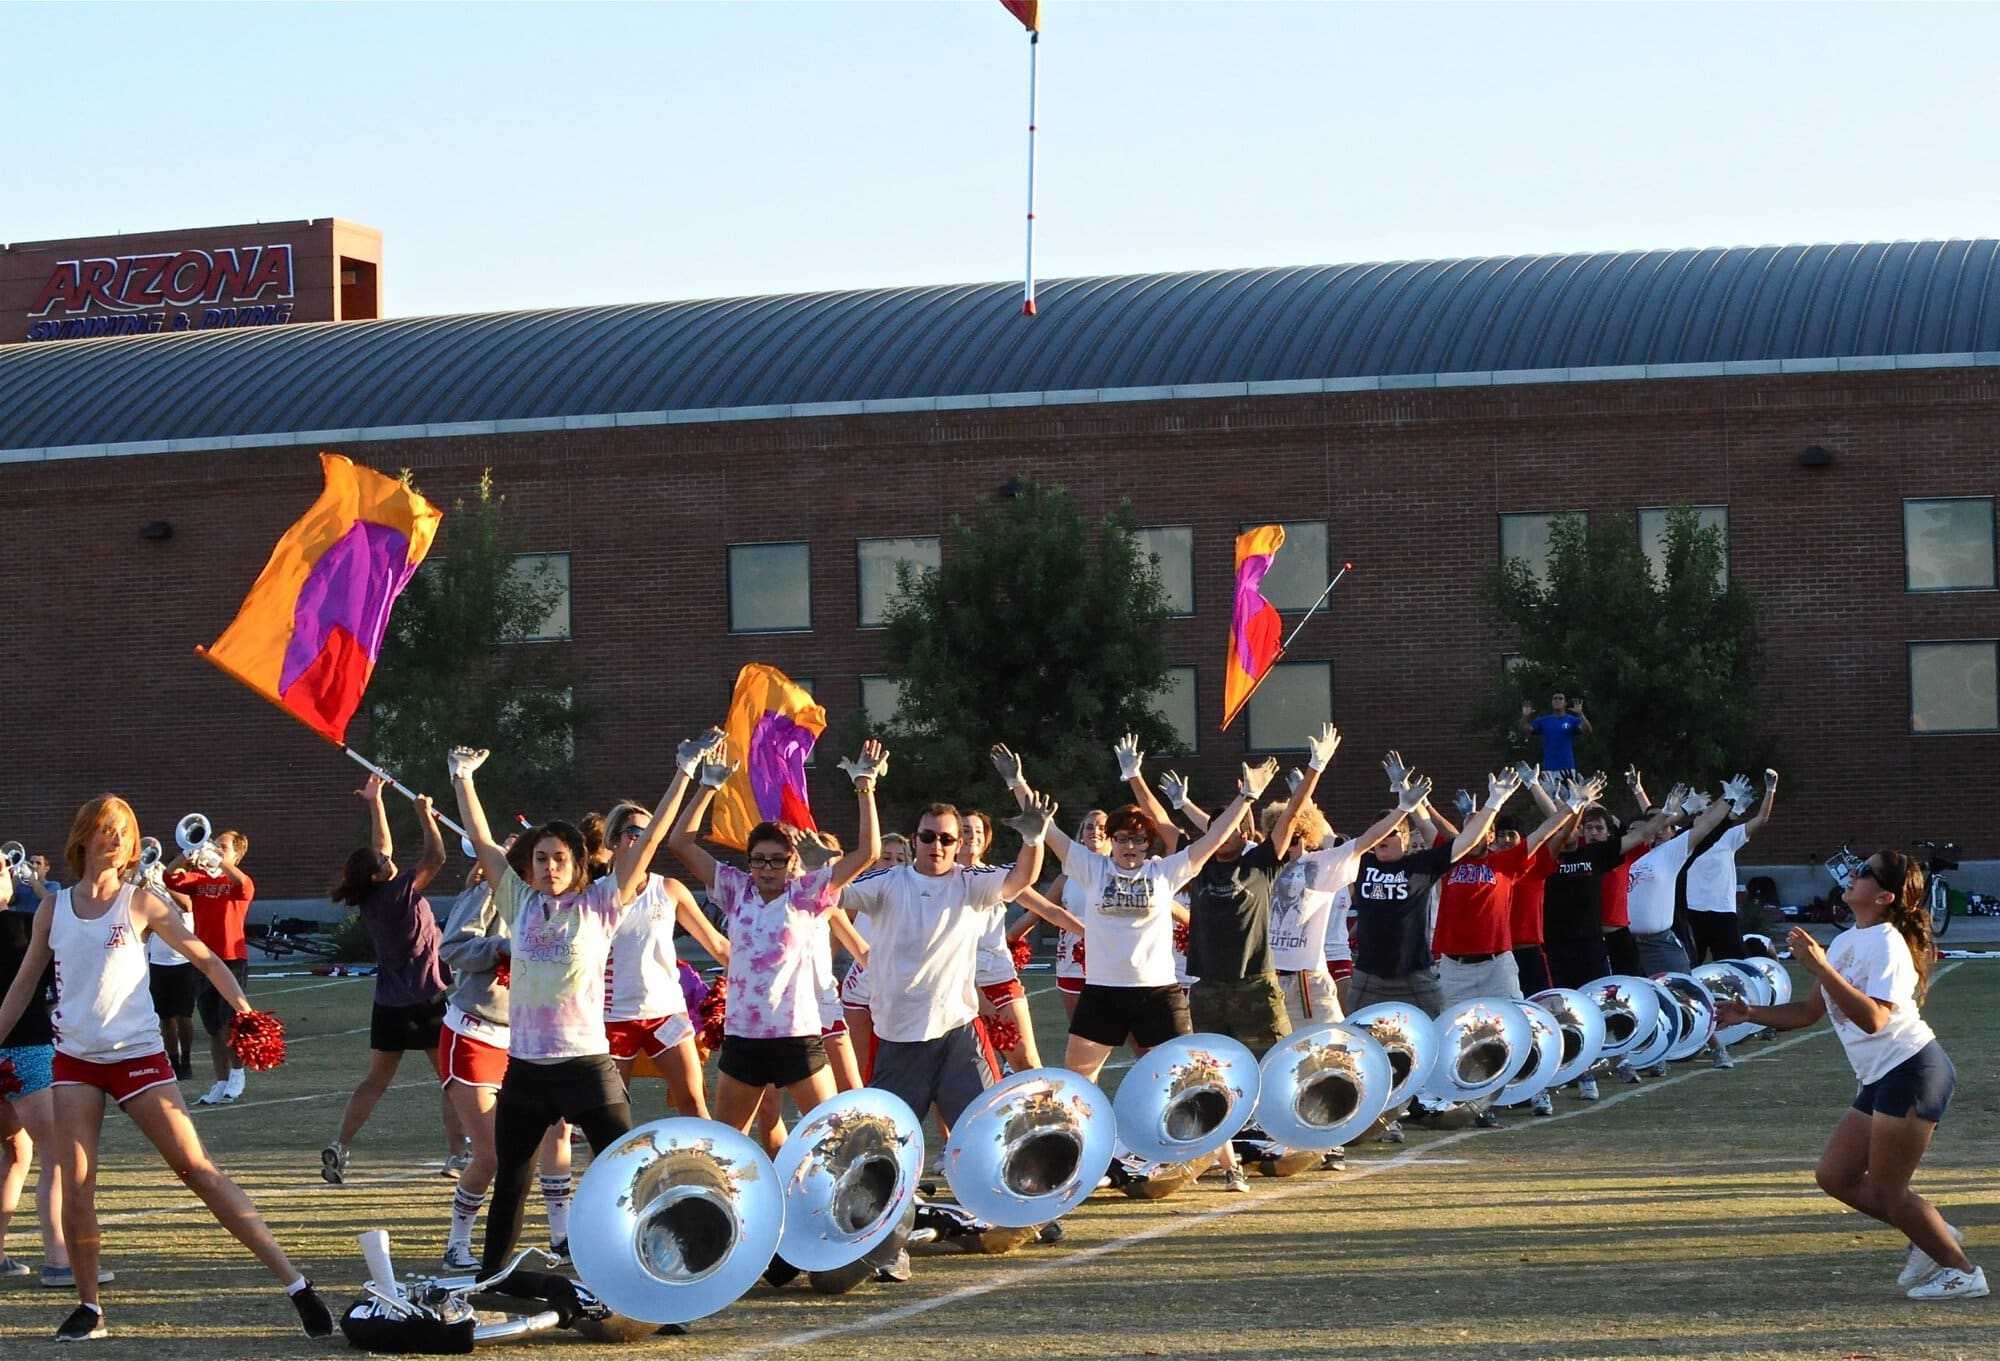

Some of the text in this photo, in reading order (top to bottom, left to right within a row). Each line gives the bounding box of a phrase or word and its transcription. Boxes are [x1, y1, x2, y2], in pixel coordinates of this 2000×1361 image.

[27, 244, 294, 317] ARIZONA
[27, 303, 294, 343] SWIMMING & DIVING
[1366, 867, 1408, 883] TUBA
[1361, 882, 1408, 900] CATS
